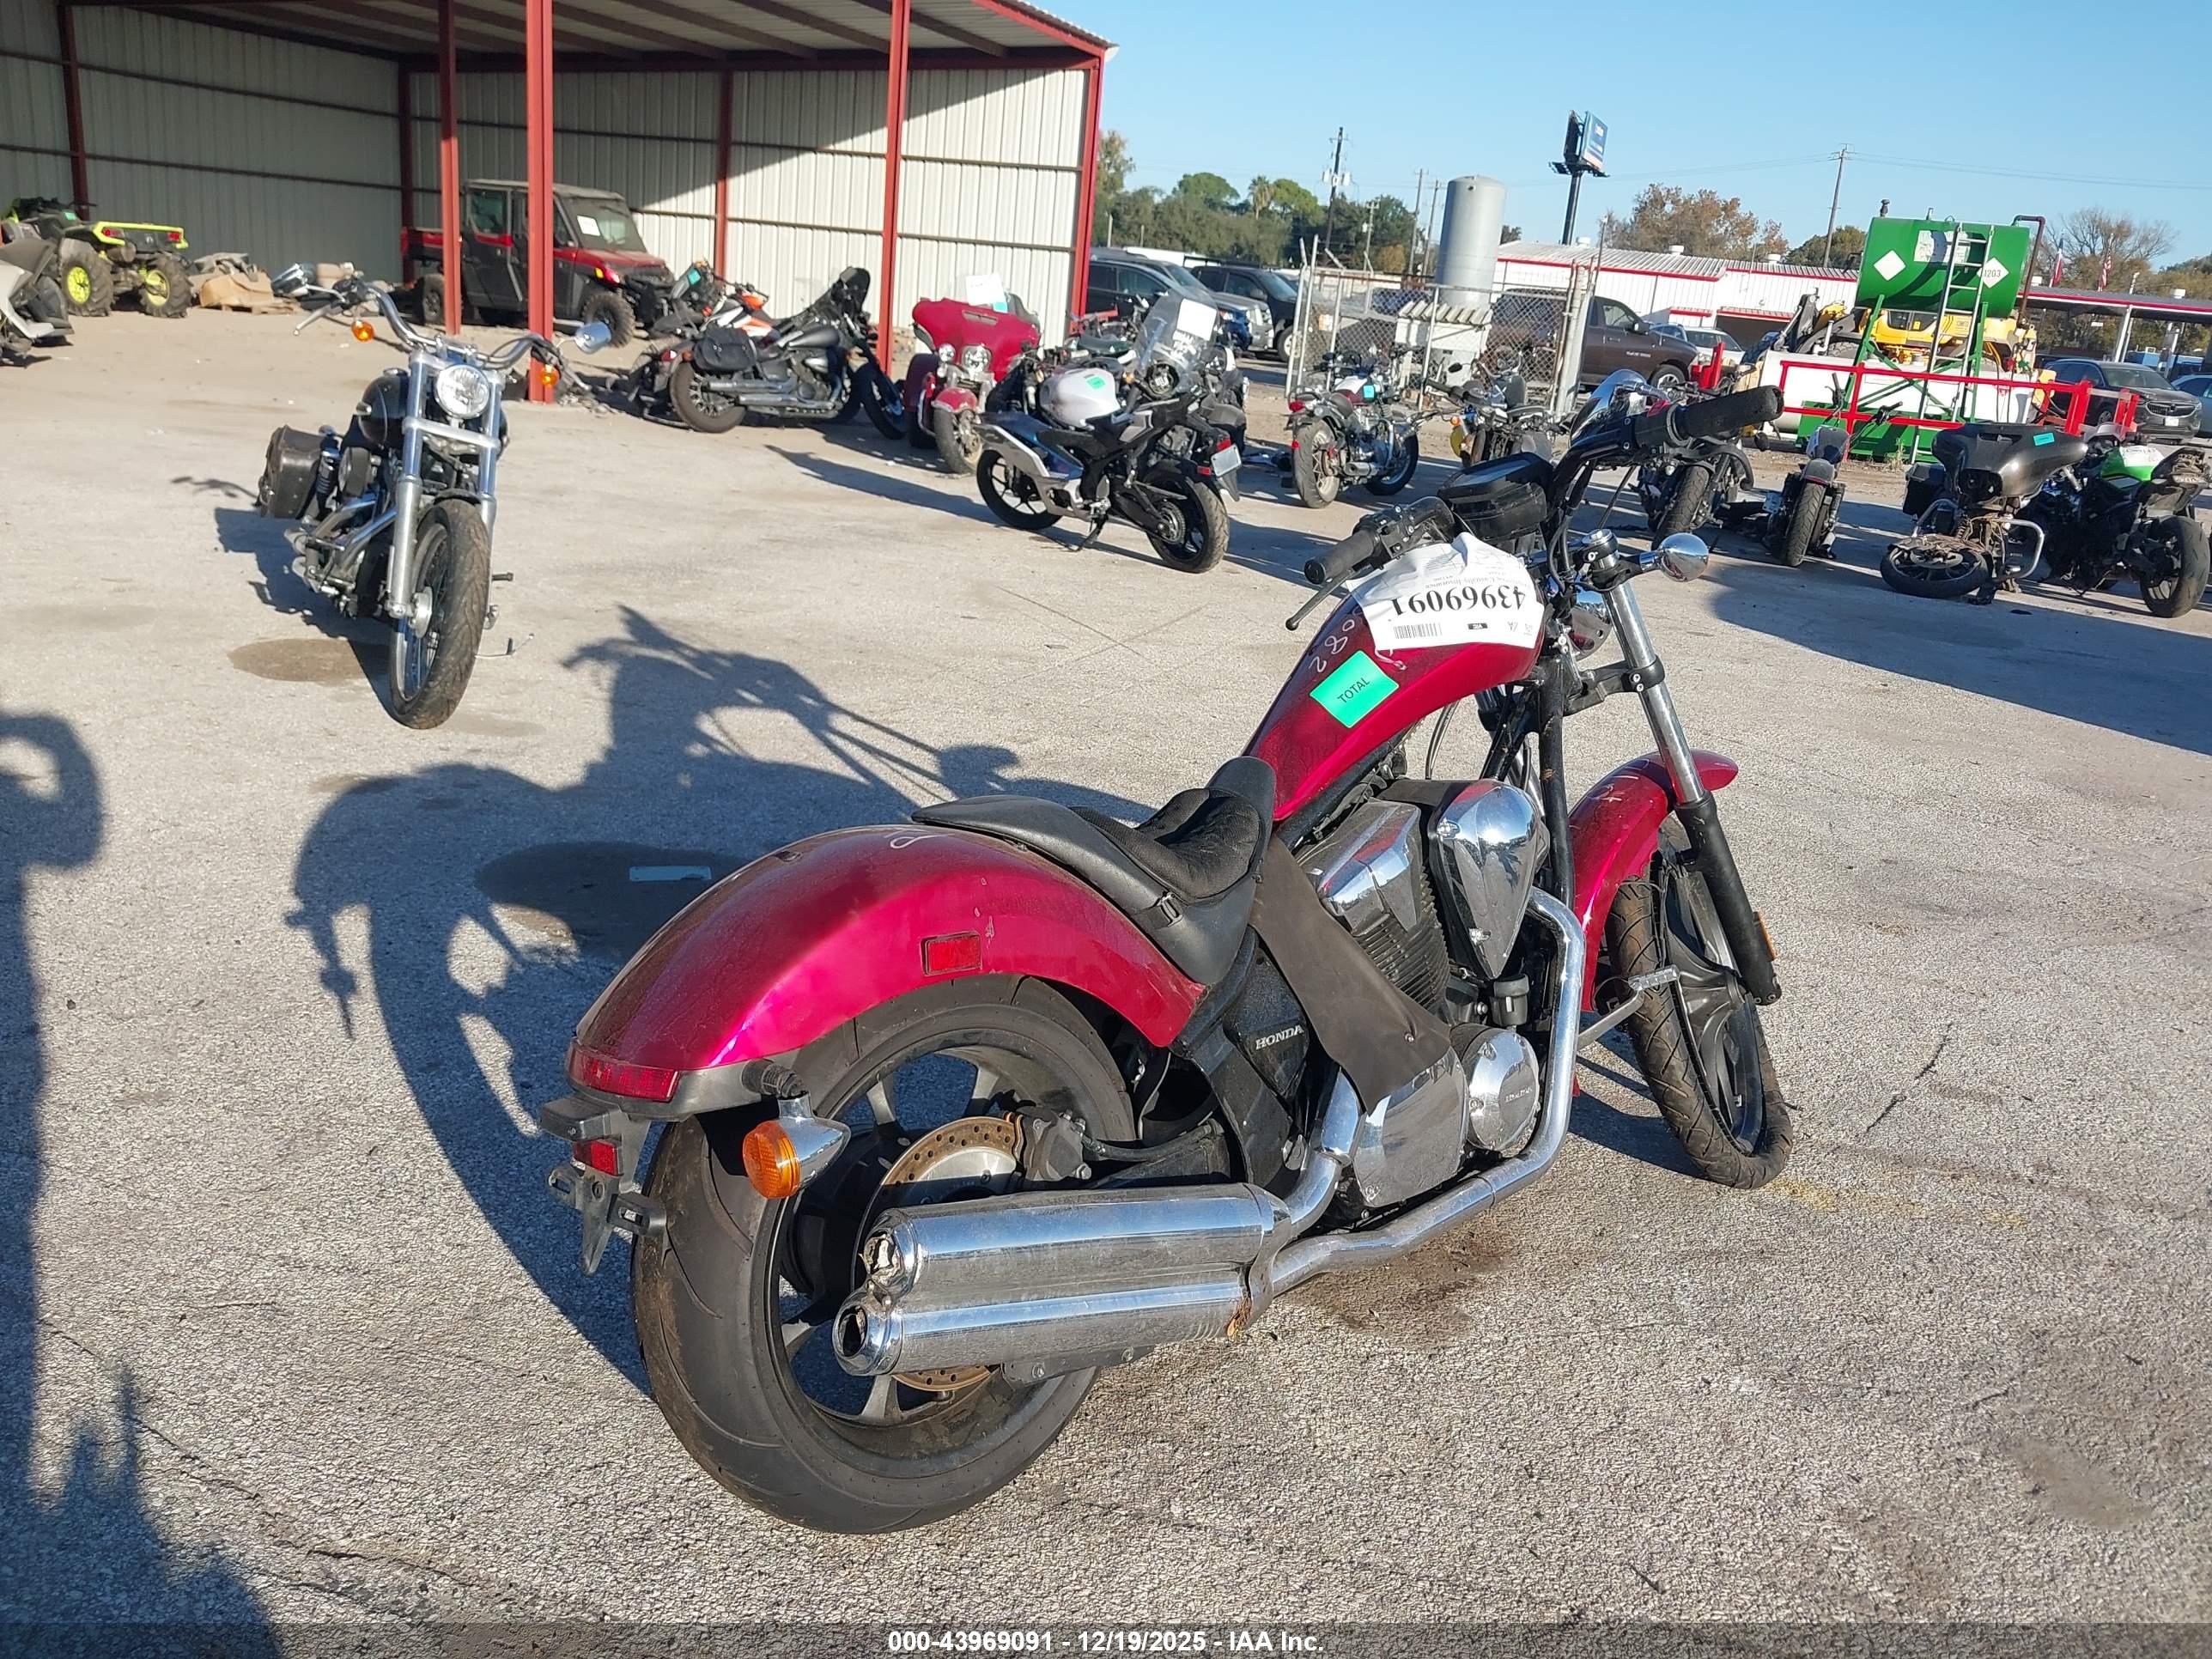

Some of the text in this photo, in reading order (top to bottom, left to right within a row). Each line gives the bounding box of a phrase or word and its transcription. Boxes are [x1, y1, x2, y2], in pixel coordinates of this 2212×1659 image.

[1391, 585, 1526, 616] 43969091
[1337, 678, 1370, 703] TOTAL
[1255, 1024, 1305, 1050] HONDA
